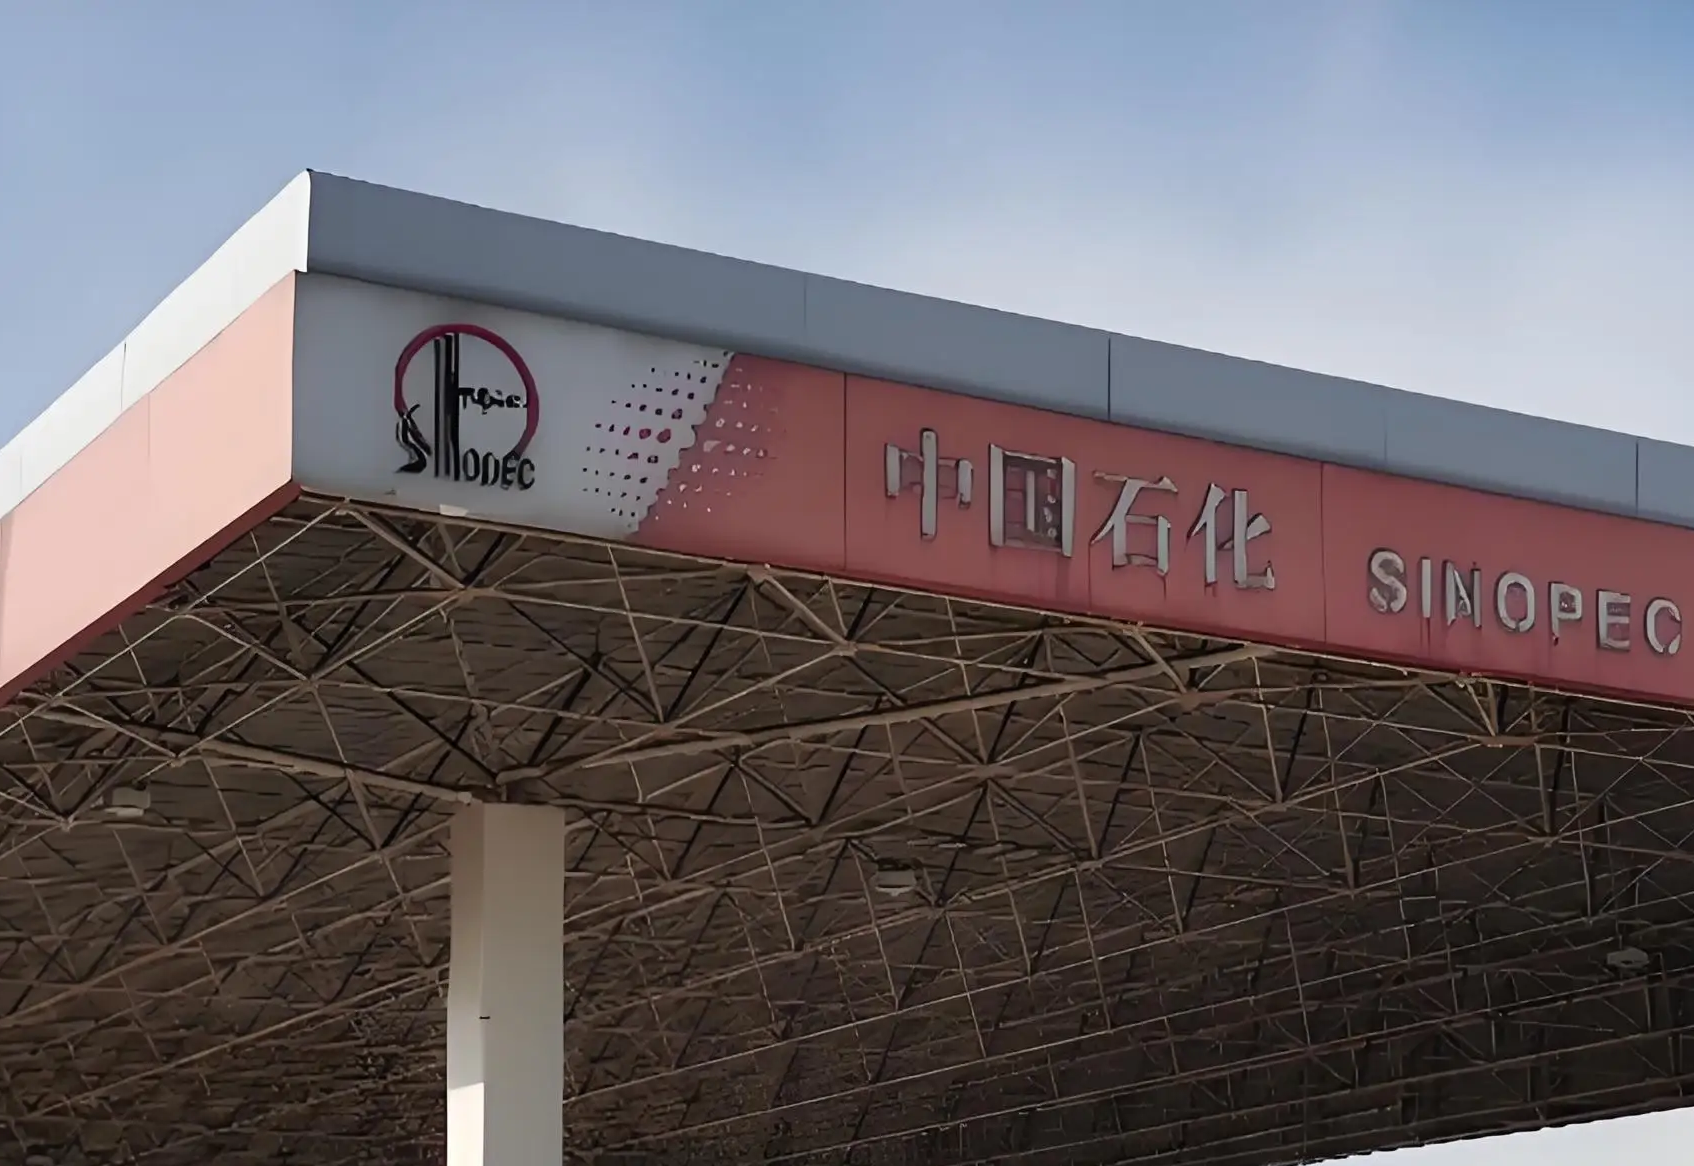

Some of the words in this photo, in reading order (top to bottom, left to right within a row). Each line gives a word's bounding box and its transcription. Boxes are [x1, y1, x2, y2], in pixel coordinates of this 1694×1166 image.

[884, 427, 1277, 592] 中国石化
[1367, 546, 1684, 657] SINOPEC
